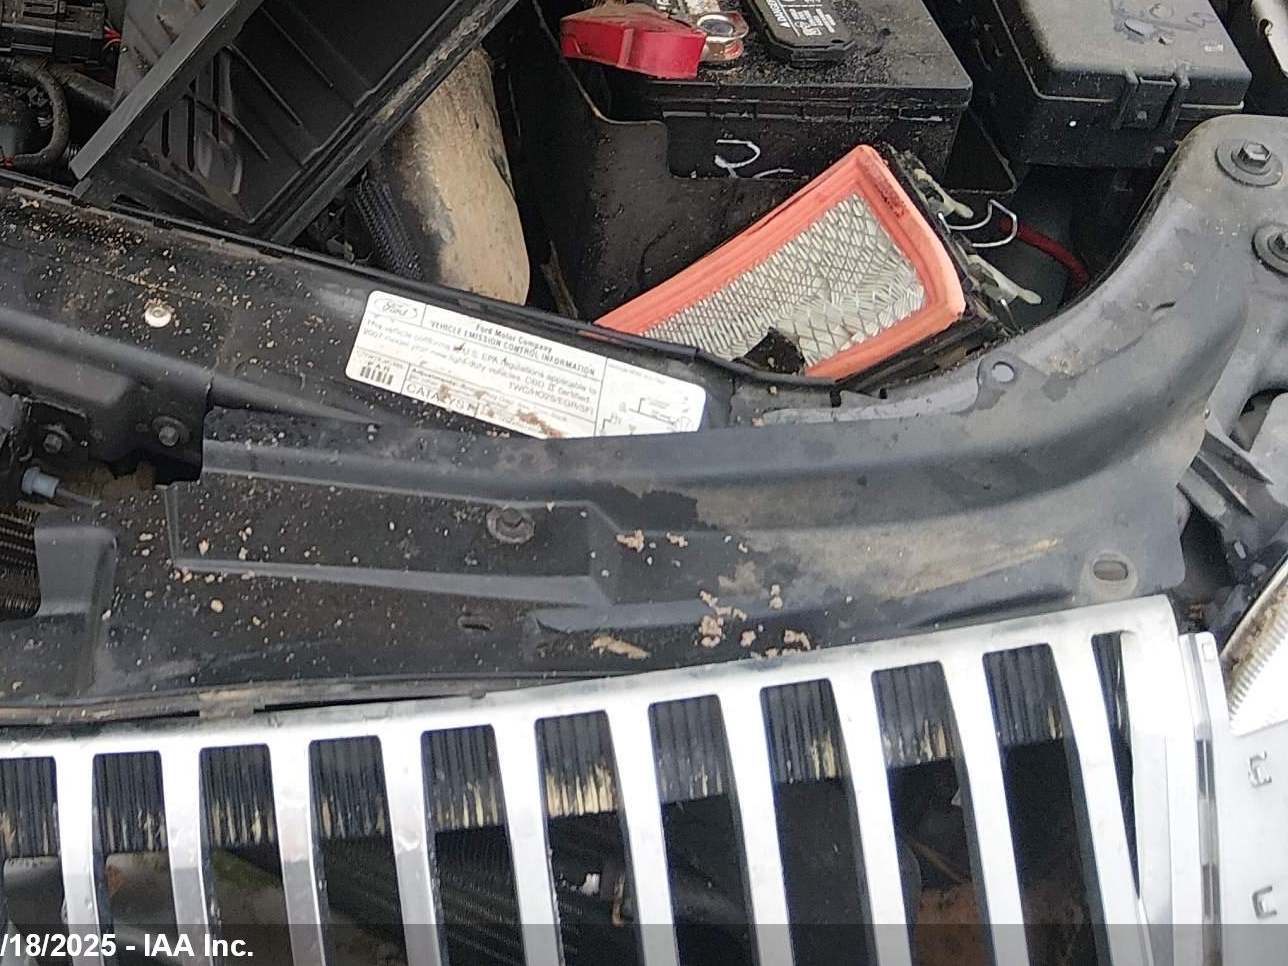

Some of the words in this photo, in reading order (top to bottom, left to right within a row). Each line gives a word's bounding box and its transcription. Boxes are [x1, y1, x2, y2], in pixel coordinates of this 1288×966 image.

[430, 320, 462, 335] VEHICLE
[463, 330, 502, 347] EMISSION
[503, 341, 540, 358] CONTROL
[541, 353, 595, 375] INFORMATION
[475, 323, 494, 336] Ford
[494, 329, 517, 343] Motor
[518, 336, 553, 353] Company
